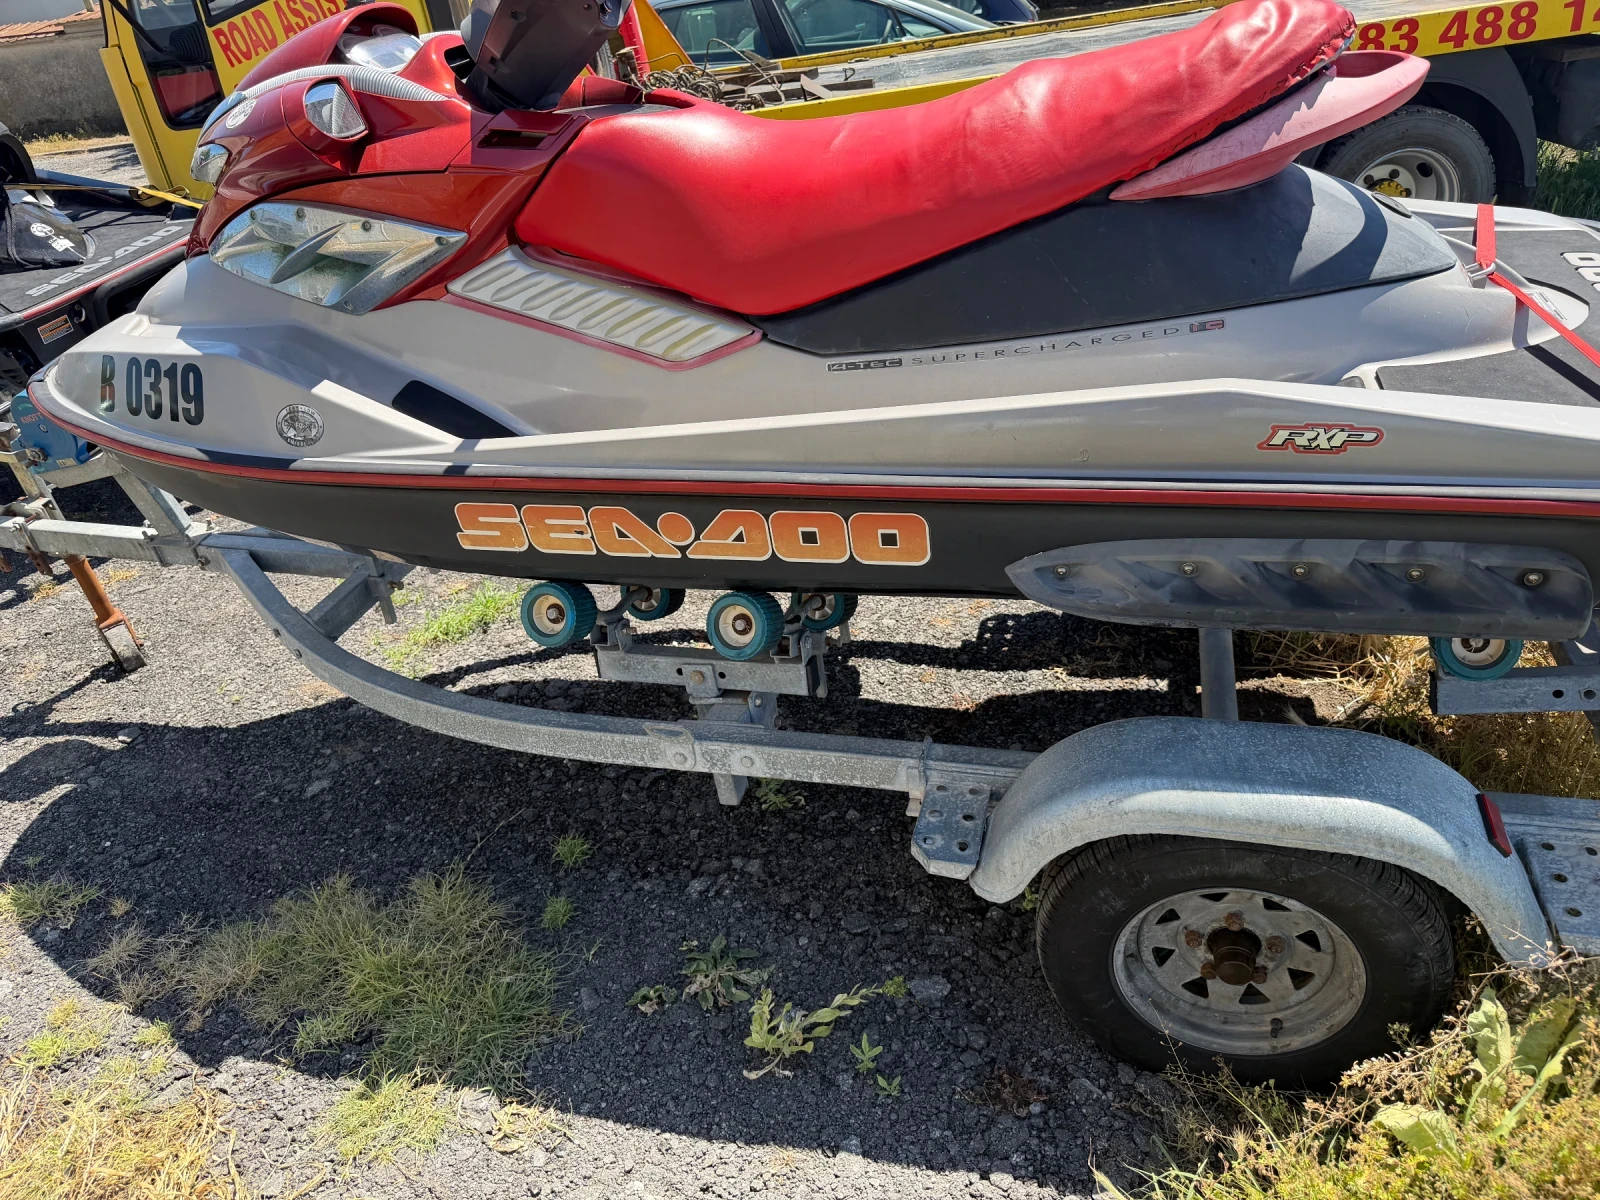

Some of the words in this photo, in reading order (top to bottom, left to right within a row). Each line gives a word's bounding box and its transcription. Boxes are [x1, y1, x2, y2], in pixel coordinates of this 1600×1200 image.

[212, 9, 278, 68] ROAD
[1347, 18, 1420, 55] 83
[1438, 1, 1539, 49] 488
[830, 359, 902, 372] 4-TEC
[911, 328, 1180, 365] SUPERCHARGED
[126, 356, 205, 426] 0319
[1266, 426, 1380, 451] RXP
